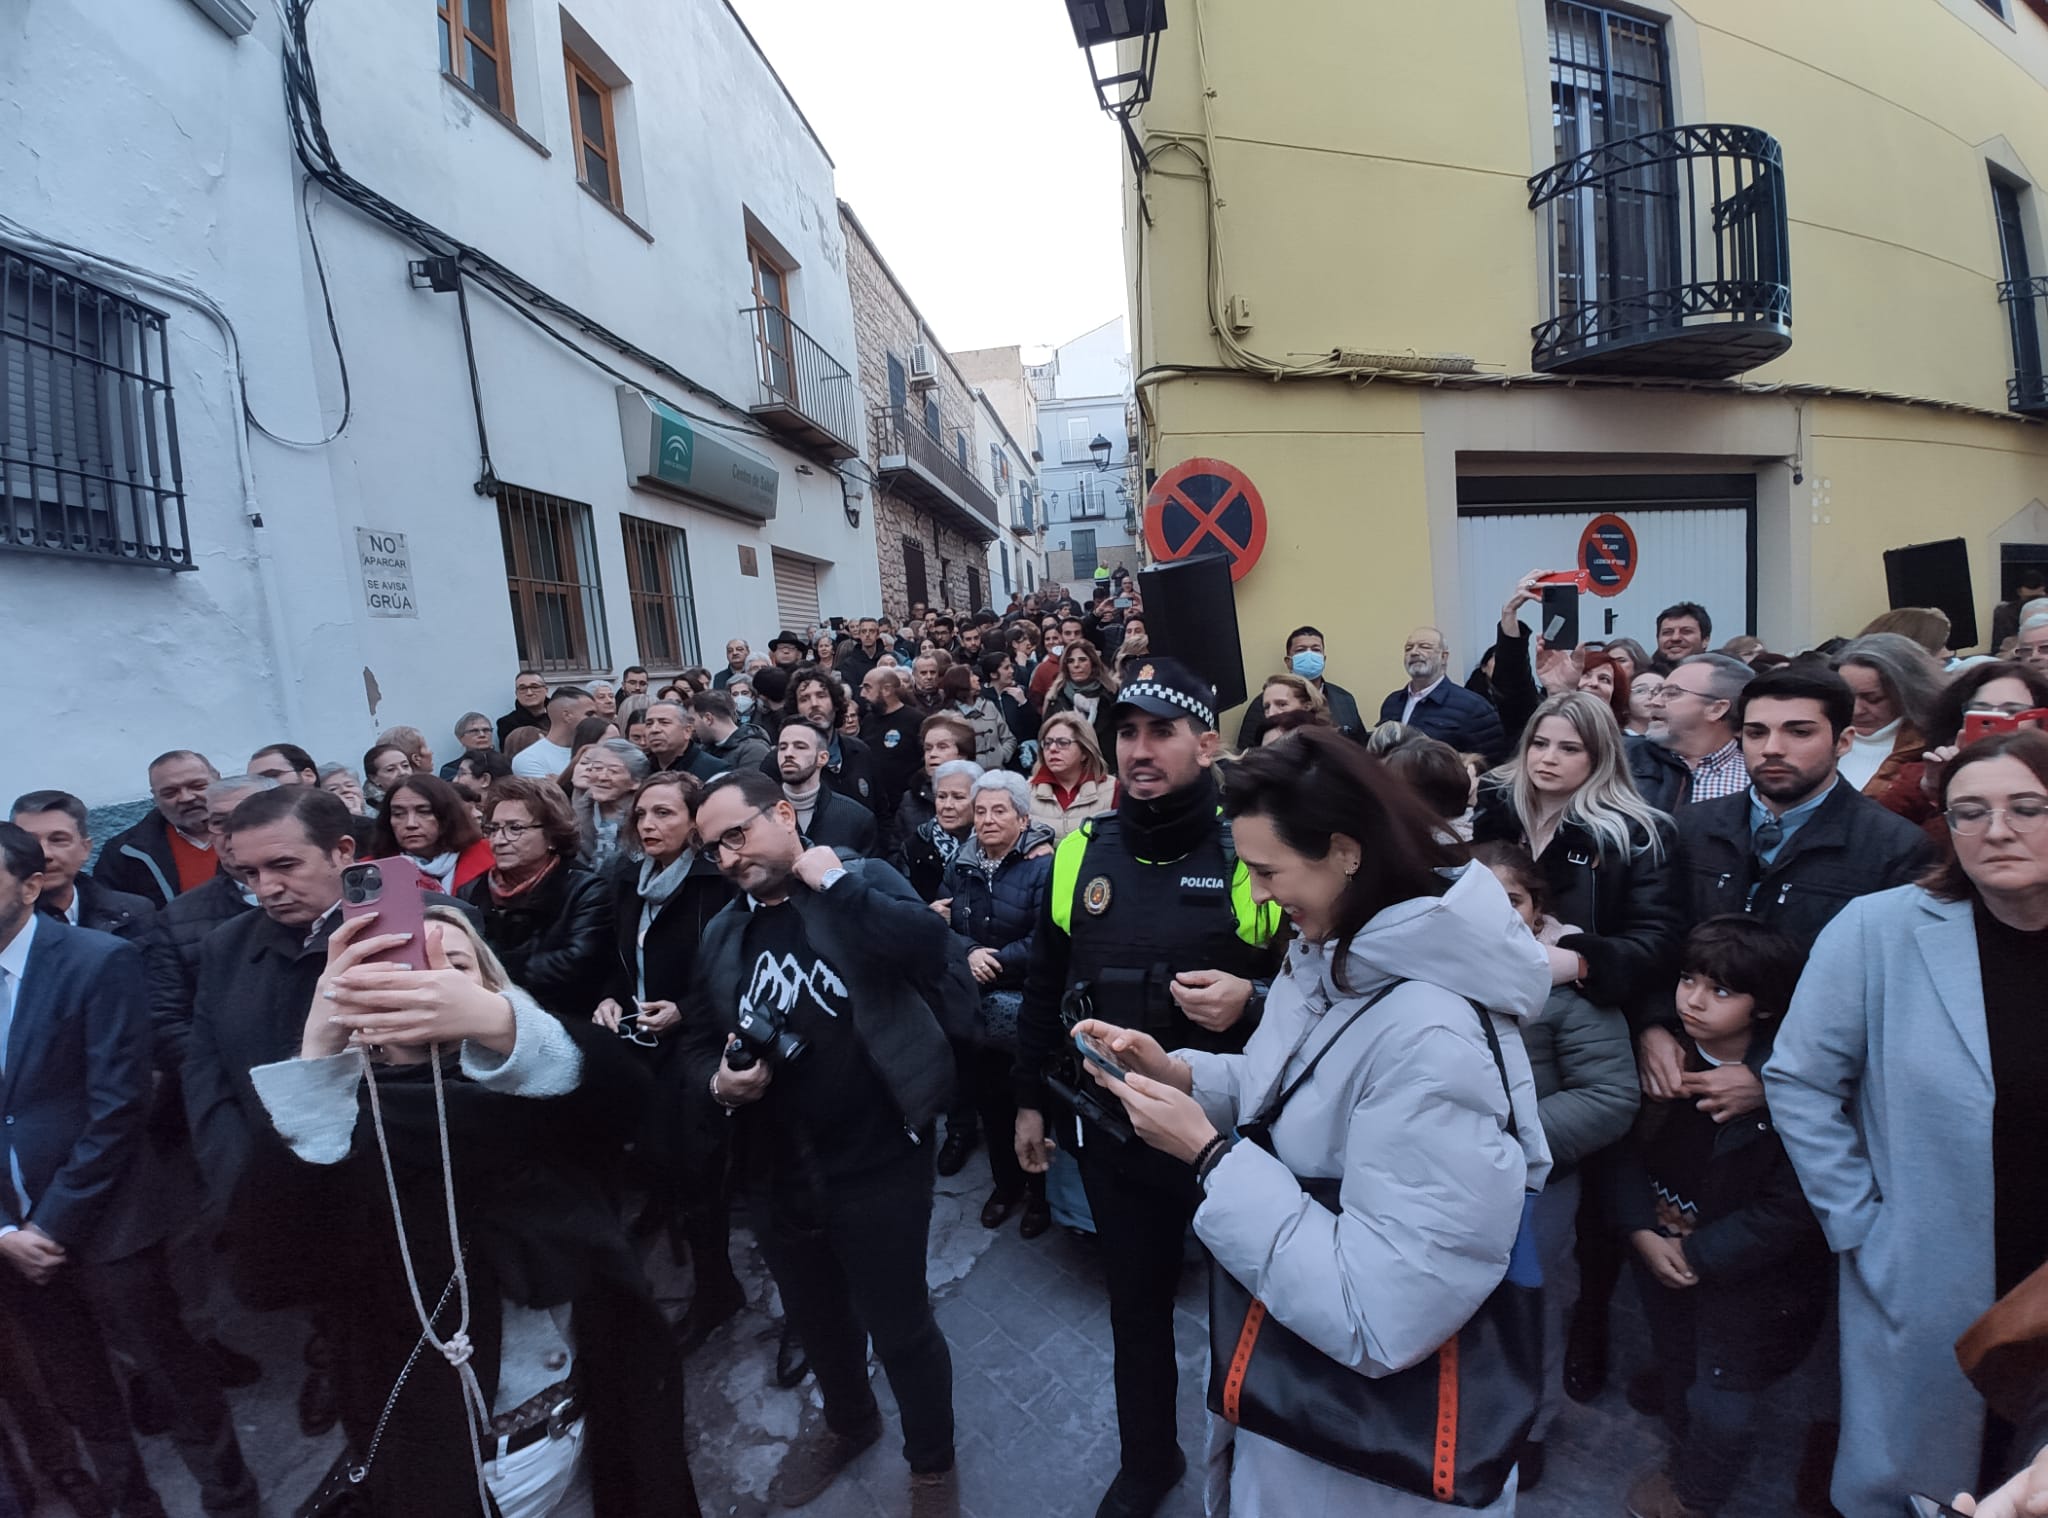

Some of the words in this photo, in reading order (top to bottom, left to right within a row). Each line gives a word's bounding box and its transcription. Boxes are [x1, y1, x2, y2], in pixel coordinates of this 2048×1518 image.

[369, 534, 396, 554] NO
[363, 555, 407, 569] APARCAR
[367, 579, 380, 590] SE
[382, 581, 408, 592] AVISA
[370, 592, 413, 610] GRÚA
[1180, 876, 1225, 889] POLICIA
